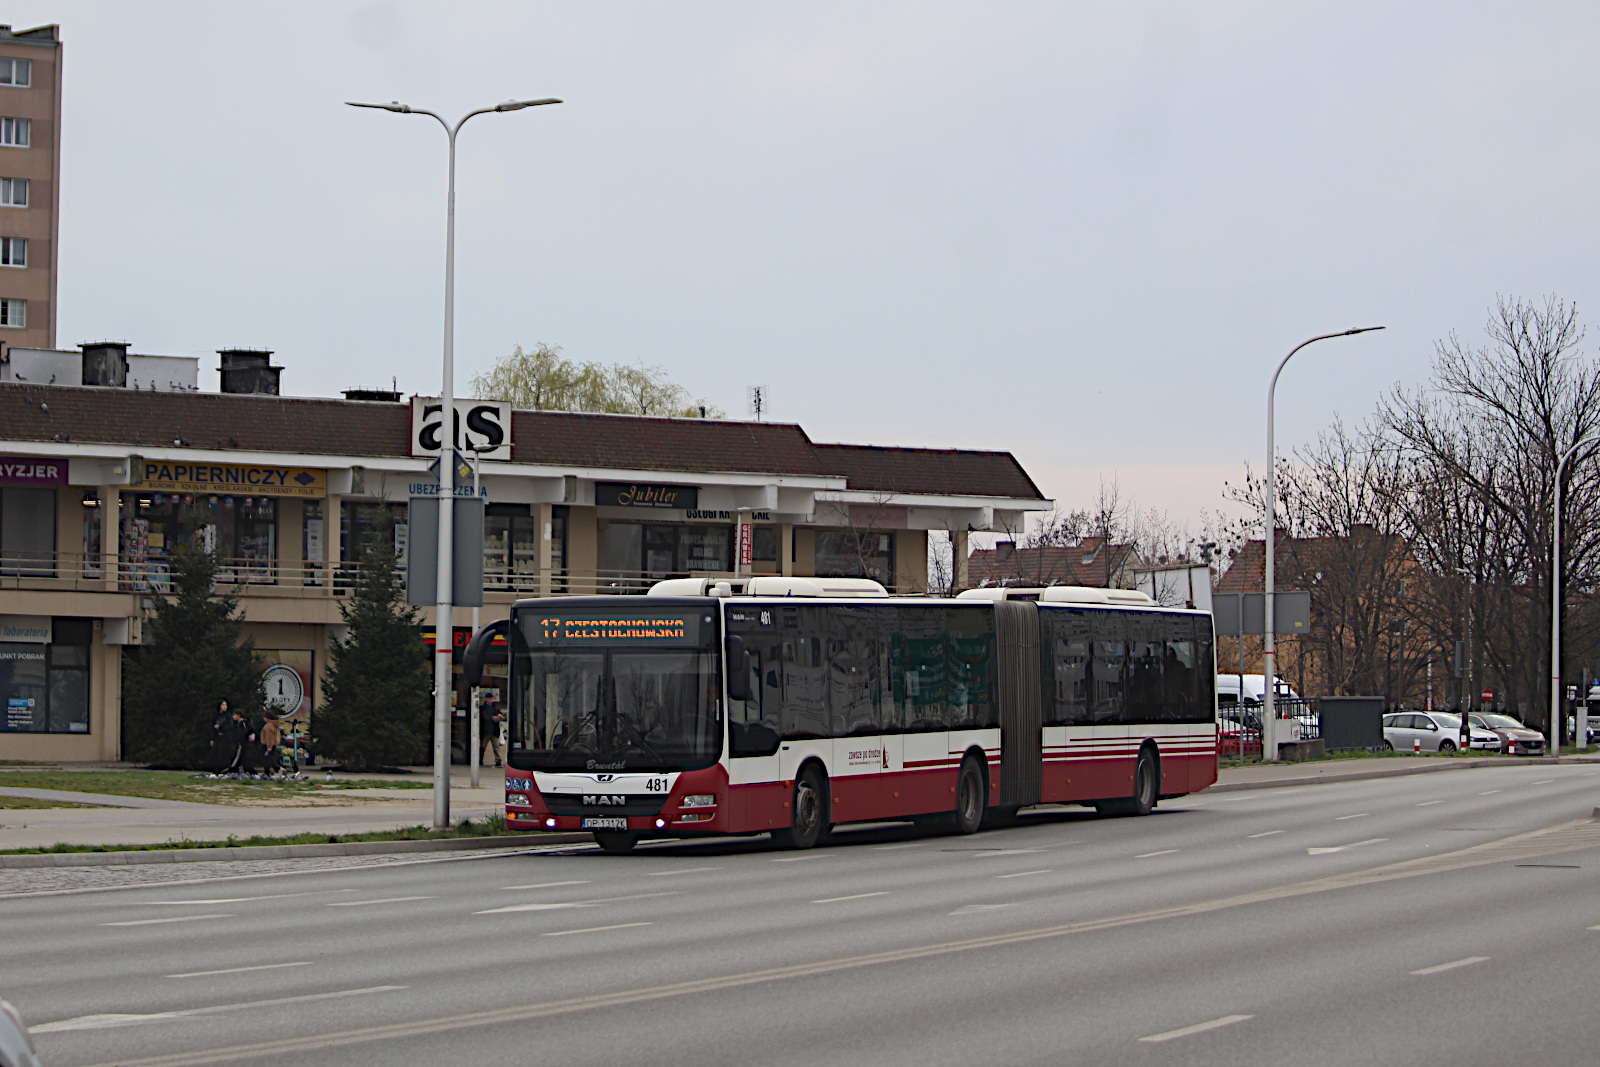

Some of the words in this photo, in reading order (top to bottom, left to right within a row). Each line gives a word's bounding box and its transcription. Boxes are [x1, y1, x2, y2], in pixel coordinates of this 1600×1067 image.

[418, 404, 503, 453] as
[145, 464, 288, 485] PAPIERNICZY
[618, 485, 678, 505] Jubiler
[761, 611, 771, 625] 481
[4, 626, 48, 637] laboratoria
[541, 618, 560, 638] 17
[18, 652, 45, 660] POBRAŃ
[278, 678, 283, 695] 1
[646, 779, 668, 792] 481
[582, 795, 626, 806] MAN
